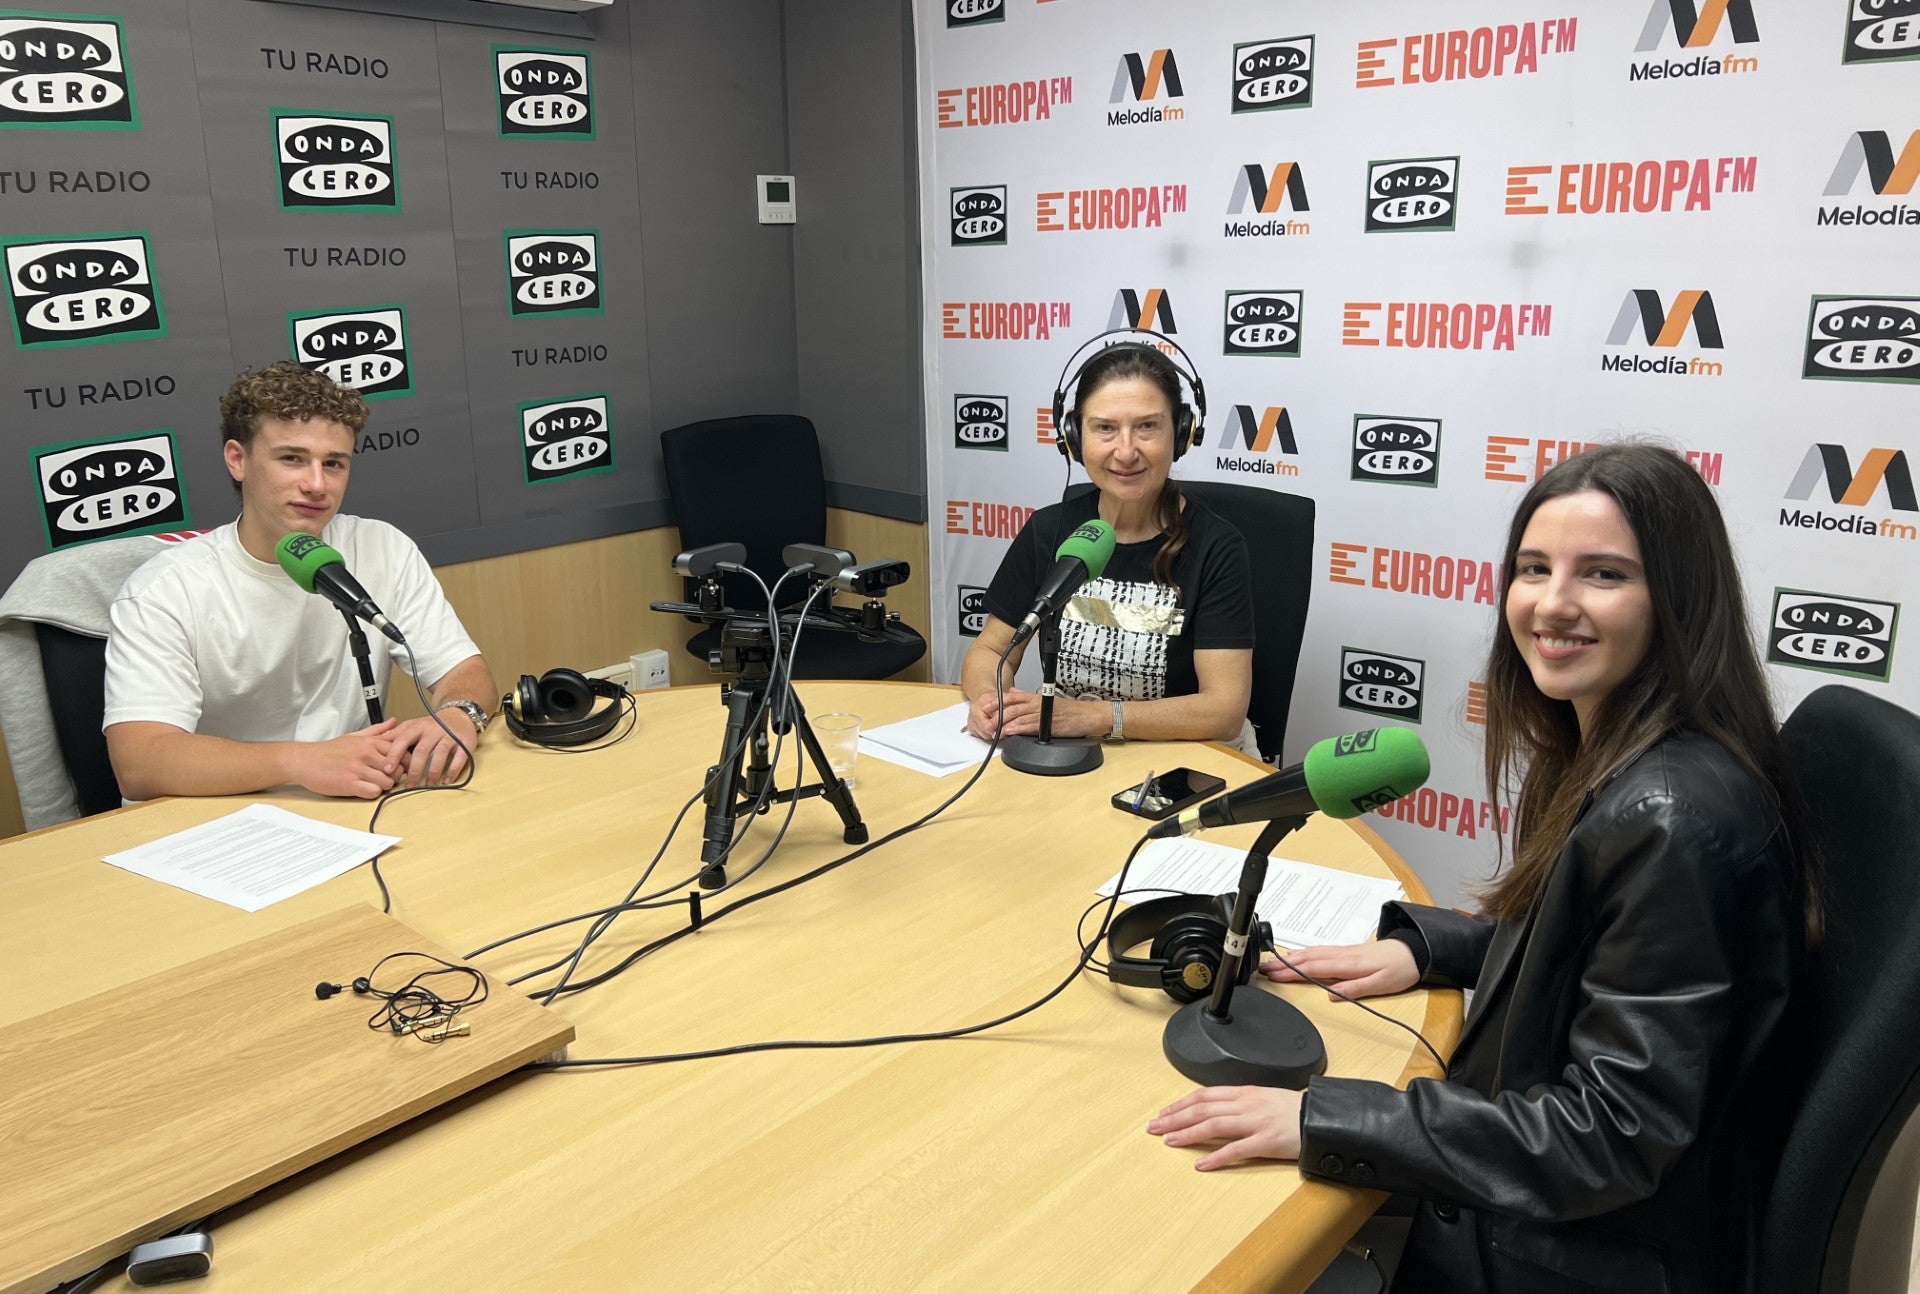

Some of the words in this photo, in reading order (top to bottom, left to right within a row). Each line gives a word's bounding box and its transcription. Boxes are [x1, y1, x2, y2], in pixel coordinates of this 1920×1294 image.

[1871, 21, 1920, 43] CE
[0, 39, 101, 60] ONDA
[261, 48, 295, 70] TU
[306, 52, 389, 79] RADIO
[1245, 54, 1300, 71] ONDA
[511, 68, 575, 86] ONDA
[12, 80, 107, 103] CERO
[1247, 79, 1299, 98] CERO
[518, 100, 577, 119] CERO
[294, 135, 375, 155] ONDA
[0, 171, 36, 194] TU
[49, 170, 151, 193] RADIO
[303, 170, 378, 190] CERO
[501, 171, 527, 189] TU
[535, 171, 599, 190] RADIO
[1381, 174, 1443, 191] ONDA
[959, 198, 998, 212] ONDA
[1382, 201, 1441, 218] CERO
[960, 219, 998, 234] CERO
[284, 248, 318, 267] TU
[328, 247, 407, 267] RADIO
[522, 251, 585, 267] ONDA
[29, 258, 130, 285] ONDA
[528, 280, 587, 299] CERO
[43, 296, 136, 324] CERO
[1236, 305, 1289, 318] ONDA
[1829, 315, 1917, 331] ONDA
[311, 328, 389, 351] ONDA
[1238, 328, 1288, 343] CERO
[512, 348, 538, 368] TU
[545, 344, 608, 365] RADIO
[1829, 345, 1914, 365] CERO
[25, 387, 67, 410] TU
[78, 374, 177, 407] RADIO
[963, 406, 1000, 419] ONDA
[535, 413, 596, 437] ONDA
[964, 427, 1000, 439] CERO
[354, 428, 420, 454] ADIO
[1366, 431, 1425, 446] ONDA
[542, 441, 599, 465] CERO
[1368, 454, 1424, 471] CERO
[60, 456, 156, 489] ONDA
[73, 491, 162, 525] CERO
[1371, 547, 1504, 606] EUROPA
[965, 598, 982, 607] ON
[968, 616, 983, 627] CE
[1790, 608, 1874, 632] ONDA
[1791, 636, 1871, 661] CERO
[1353, 663, 1410, 684] ONDA
[1355, 686, 1408, 706] CERO
